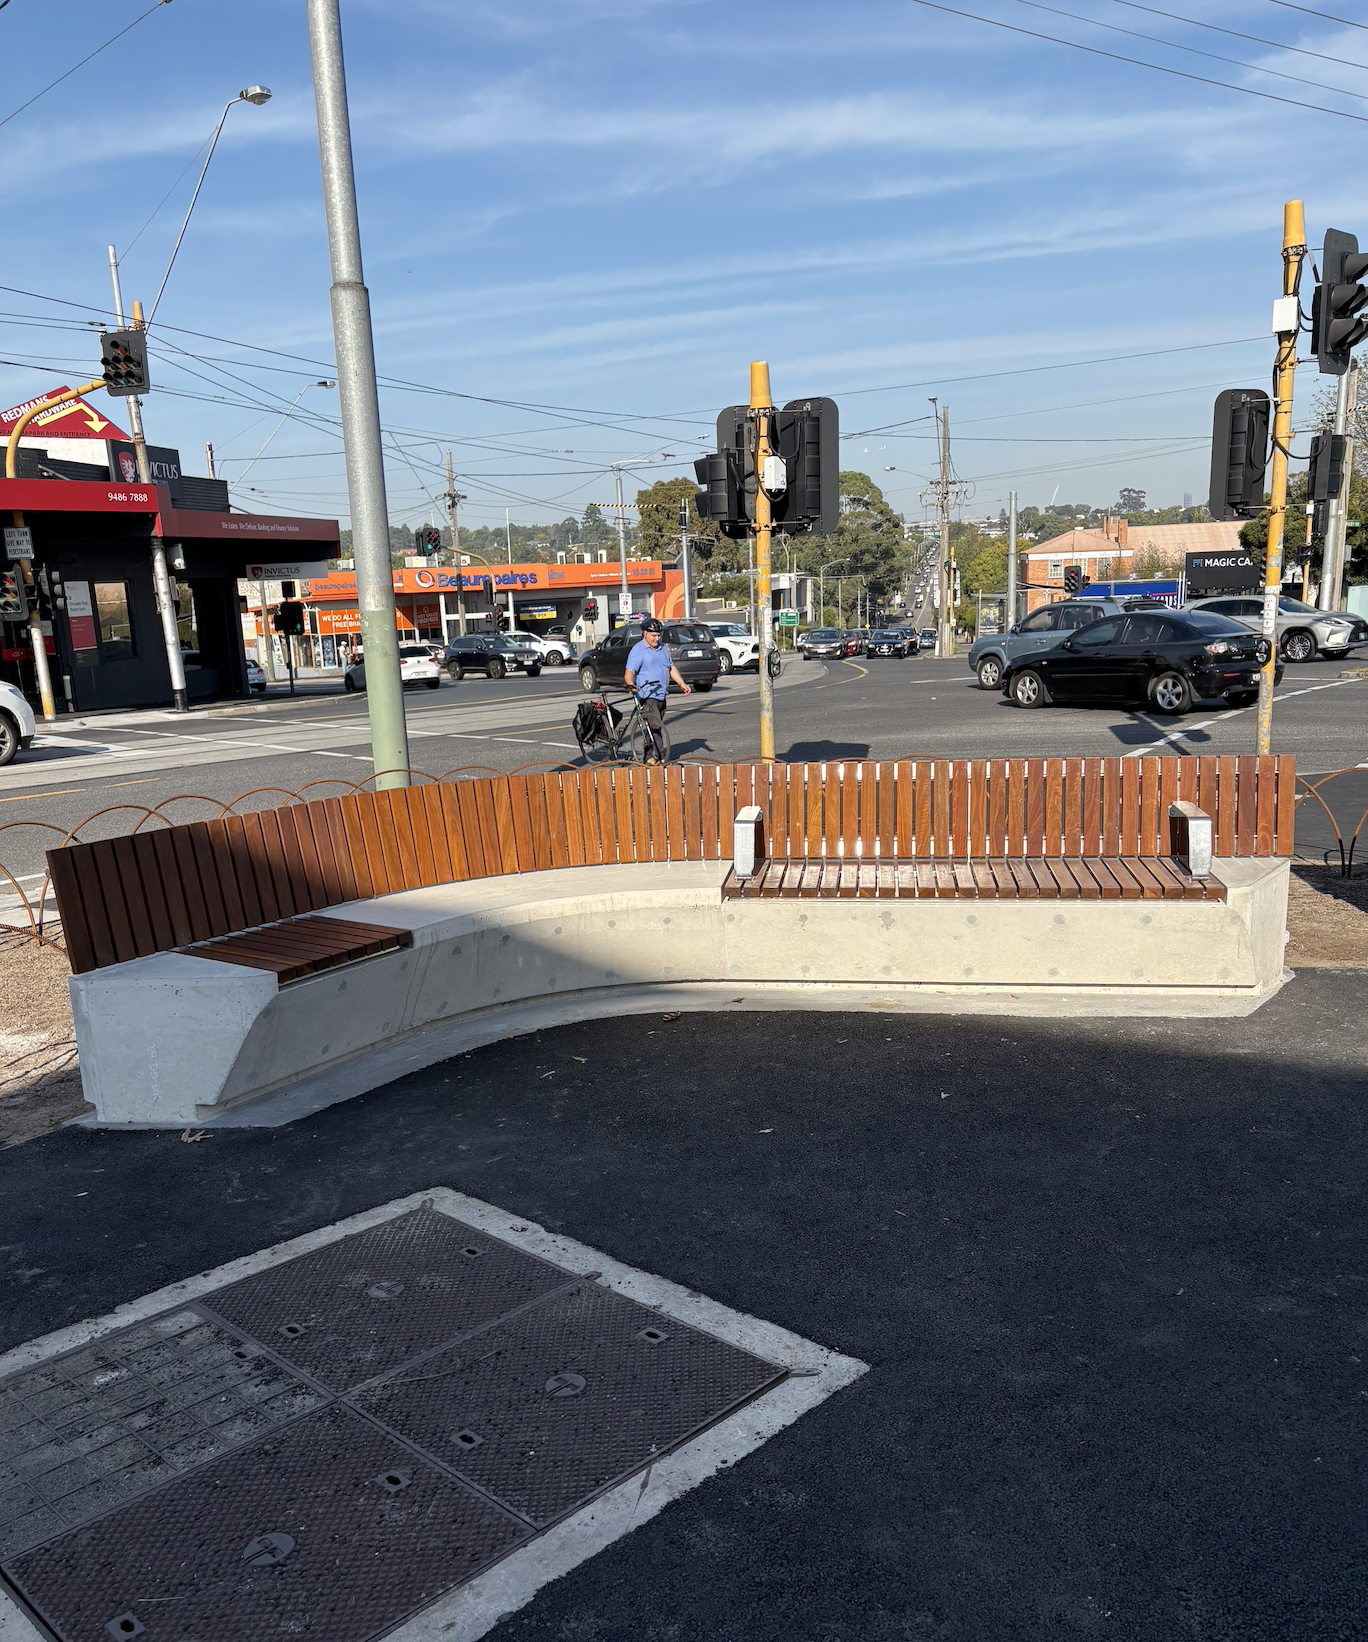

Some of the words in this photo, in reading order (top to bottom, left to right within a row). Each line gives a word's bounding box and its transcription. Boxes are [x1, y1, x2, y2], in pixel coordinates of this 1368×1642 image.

[107, 492, 128, 502] 9486
[129, 492, 148, 502] 7888
[9, 548, 31, 556] PEDESTRIANS
[1204, 558, 1236, 568] MAGIC
[1237, 557, 1254, 567] CA
[264, 566, 301, 575] INVICTUS
[436, 570, 538, 588] Beaurepaires
